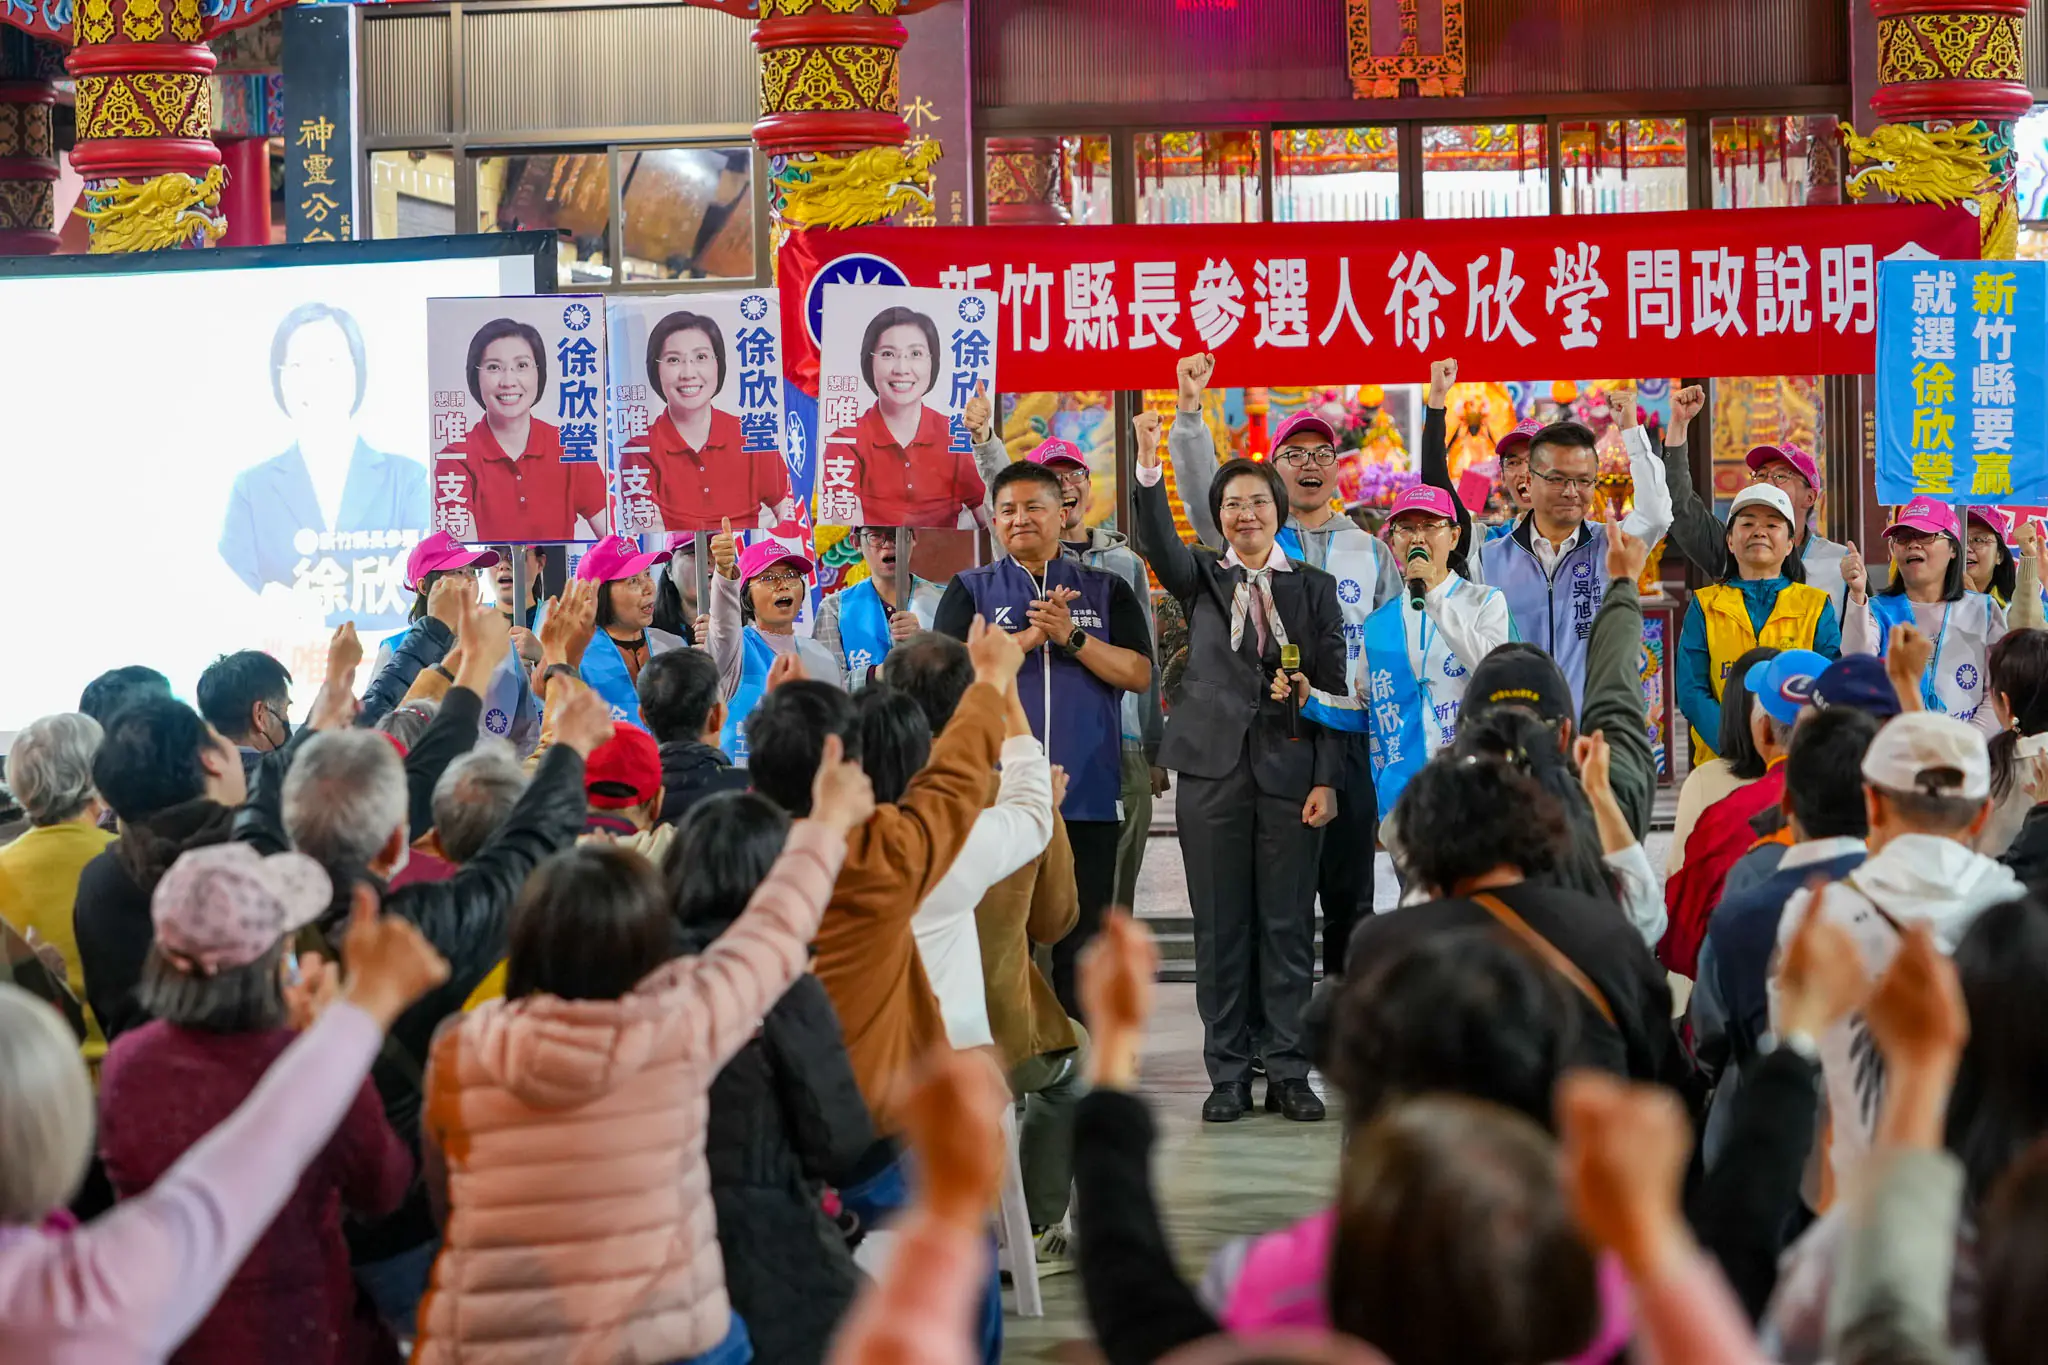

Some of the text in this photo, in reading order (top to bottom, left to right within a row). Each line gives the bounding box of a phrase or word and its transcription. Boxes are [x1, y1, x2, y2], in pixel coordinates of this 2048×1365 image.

[938, 240, 1941, 354] 竹縣長參選人徐欣瑩問政說明
[557, 336, 599, 463] 徐欣瑩
[736, 326, 780, 453] 徐欣瑩
[1911, 270, 1957, 494] 就選徐欣瑩
[1971, 271, 2017, 495] 新竹縣要贏
[434, 410, 470, 537] 唯一支持
[616, 403, 655, 530] 唯一支持
[823, 396, 860, 520] 唯一支持
[292, 554, 412, 616] 徐欣
[1371, 668, 1405, 766] 徐欣瑩
